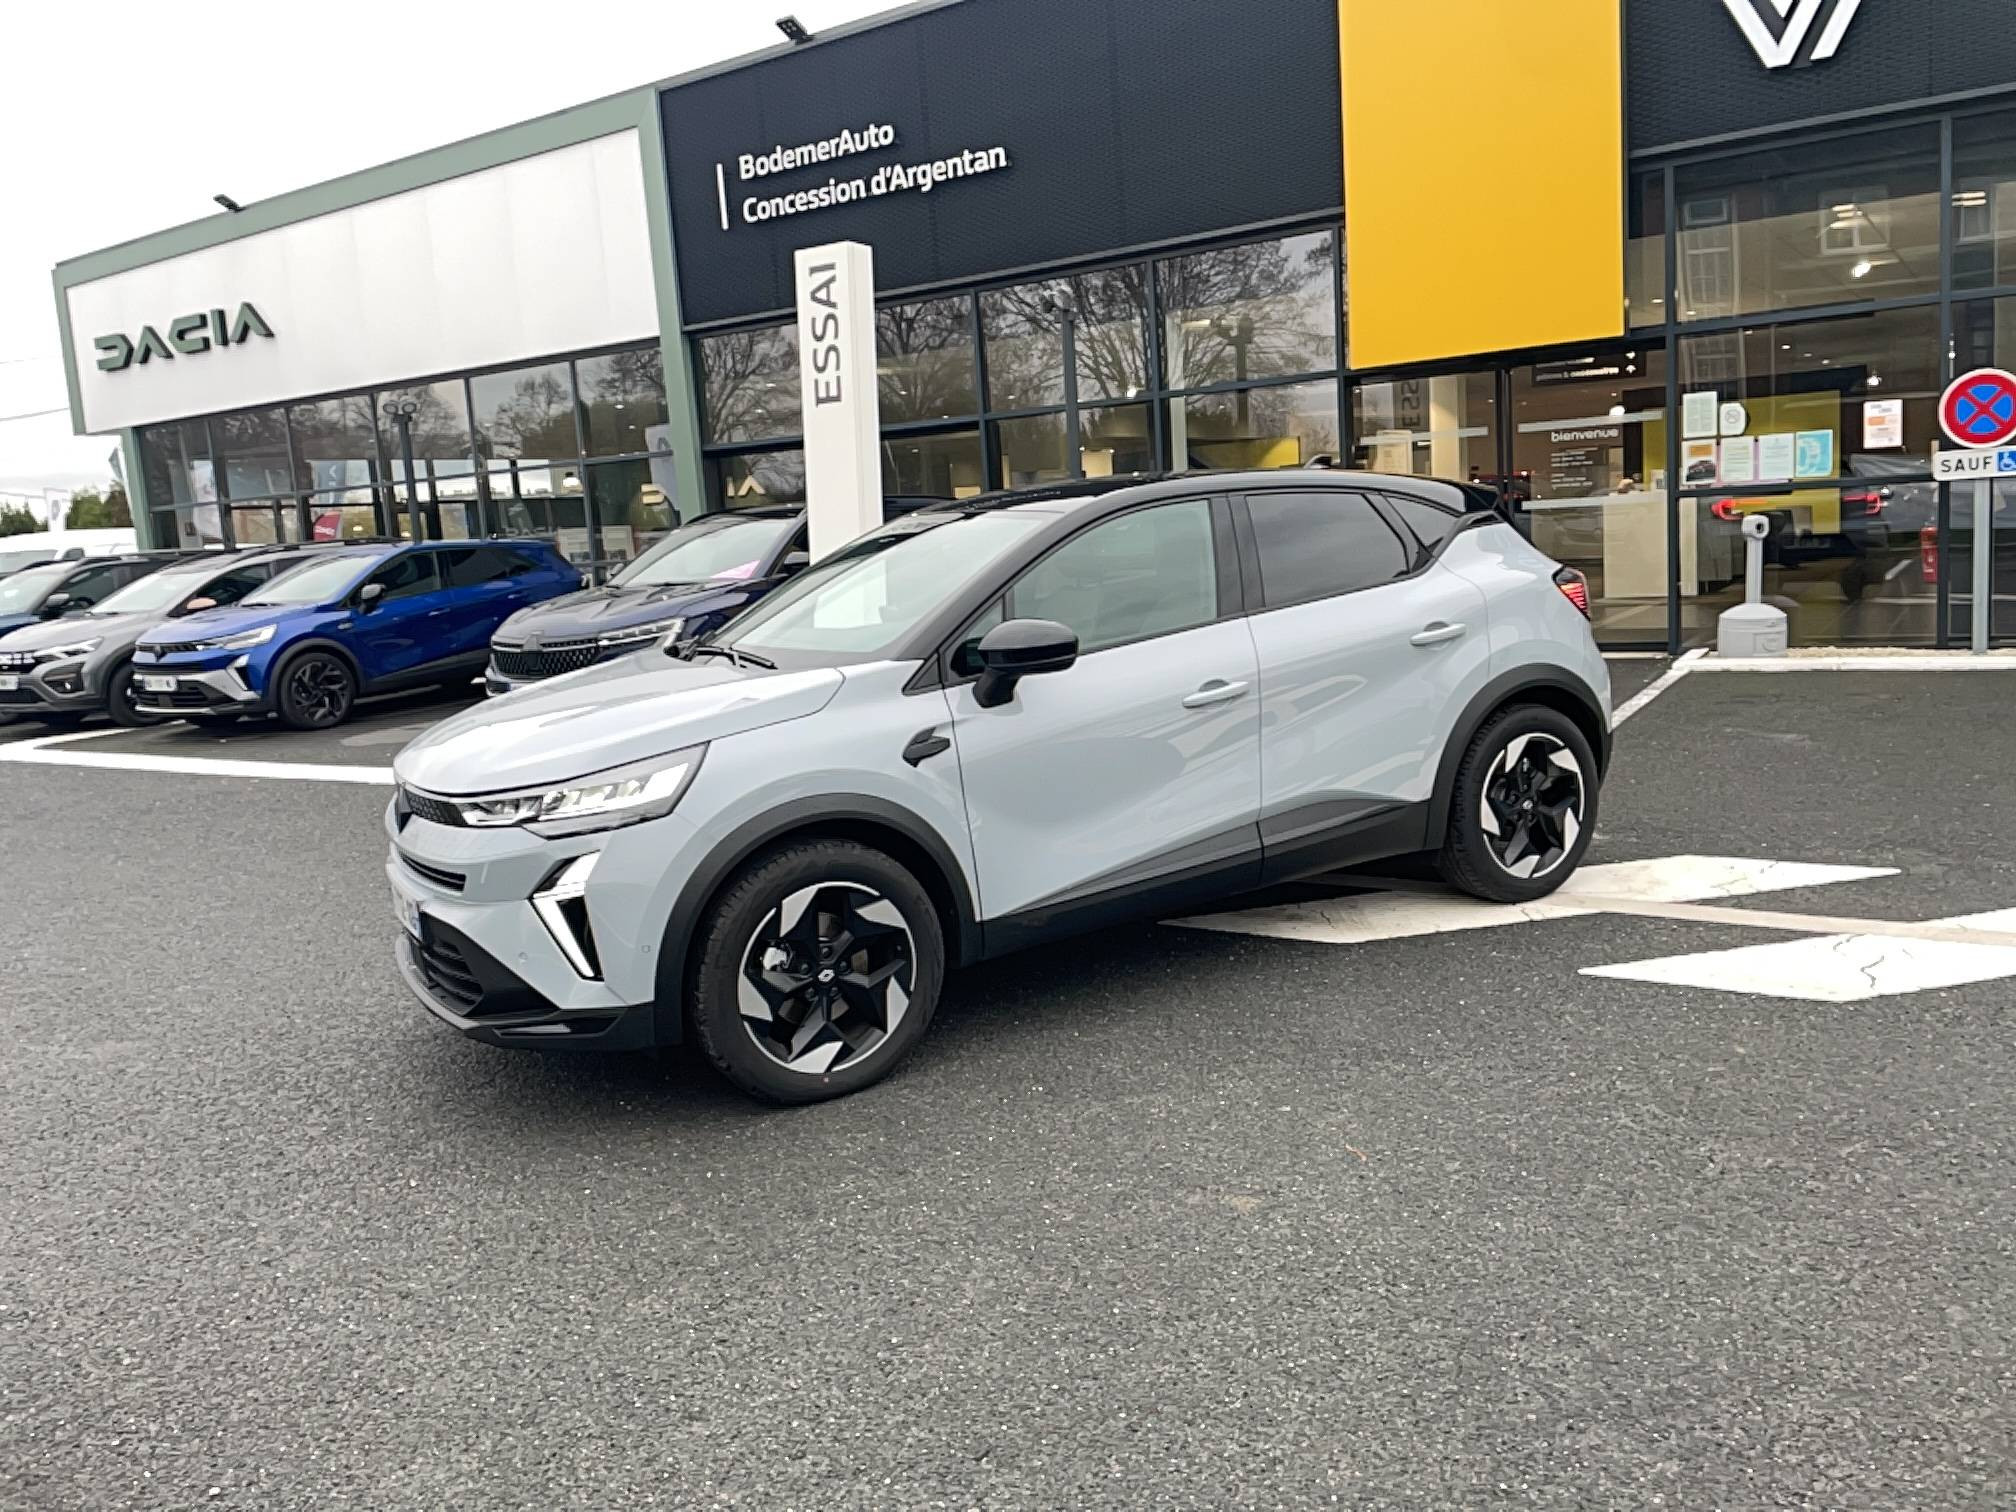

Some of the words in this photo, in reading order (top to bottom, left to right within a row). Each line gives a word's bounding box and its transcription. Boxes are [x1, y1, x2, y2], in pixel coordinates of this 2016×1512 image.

[738, 123, 895, 180] BodemerAuto
[742, 178, 867, 224] Concession
[870, 146, 1008, 193] d'Argentan
[93, 300, 275, 372] DACIA
[808, 261, 843, 408] ESSAI
[1550, 428, 1620, 443] bienvenue
[1940, 455, 1994, 473] SAUF
